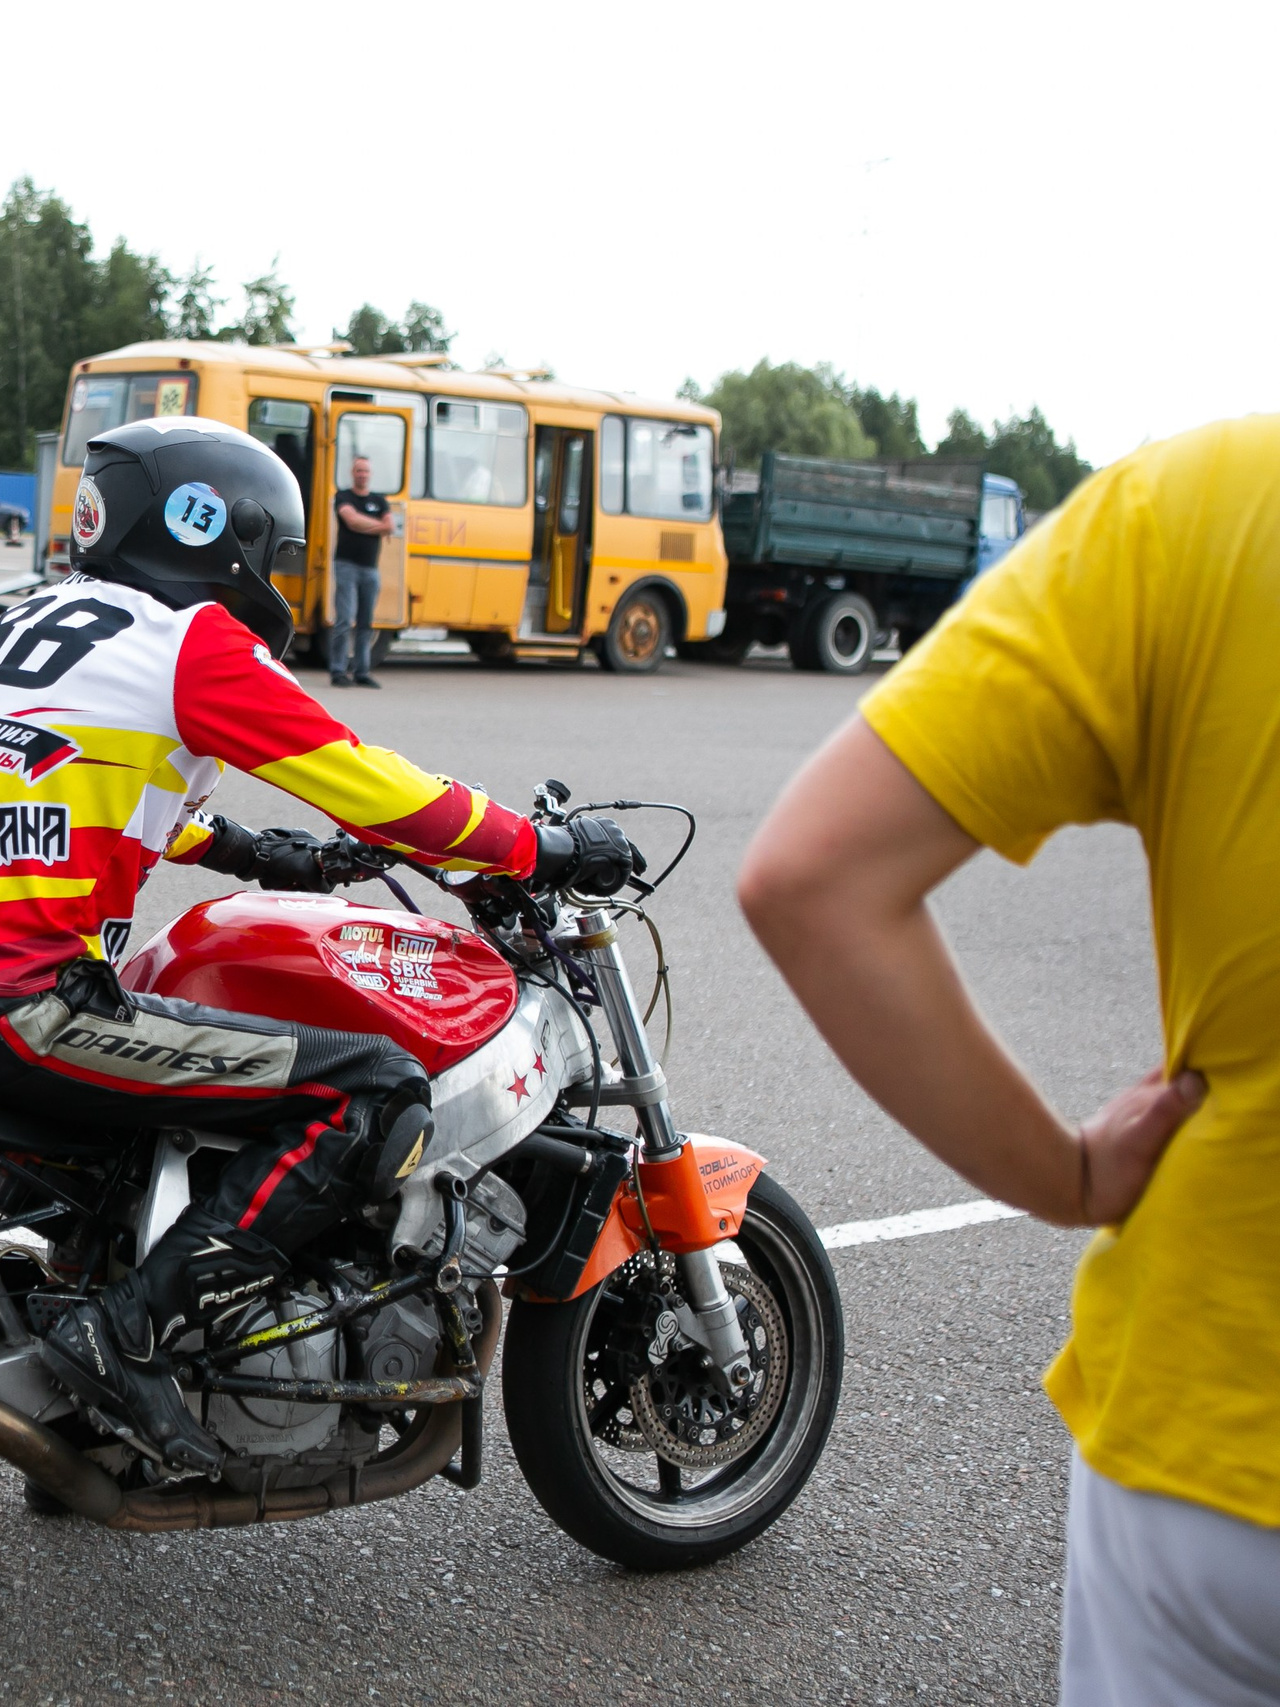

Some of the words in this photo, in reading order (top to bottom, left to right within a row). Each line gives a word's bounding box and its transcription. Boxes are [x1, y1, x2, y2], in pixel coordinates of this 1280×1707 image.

[180, 495, 218, 534] 13
[340, 926, 385, 942] MOTUL
[340, 942, 384, 971] SHARK
[389, 959, 436, 980] SBK
[352, 974, 384, 987] SHOEI
[393, 975, 439, 989] SUPERBIKE
